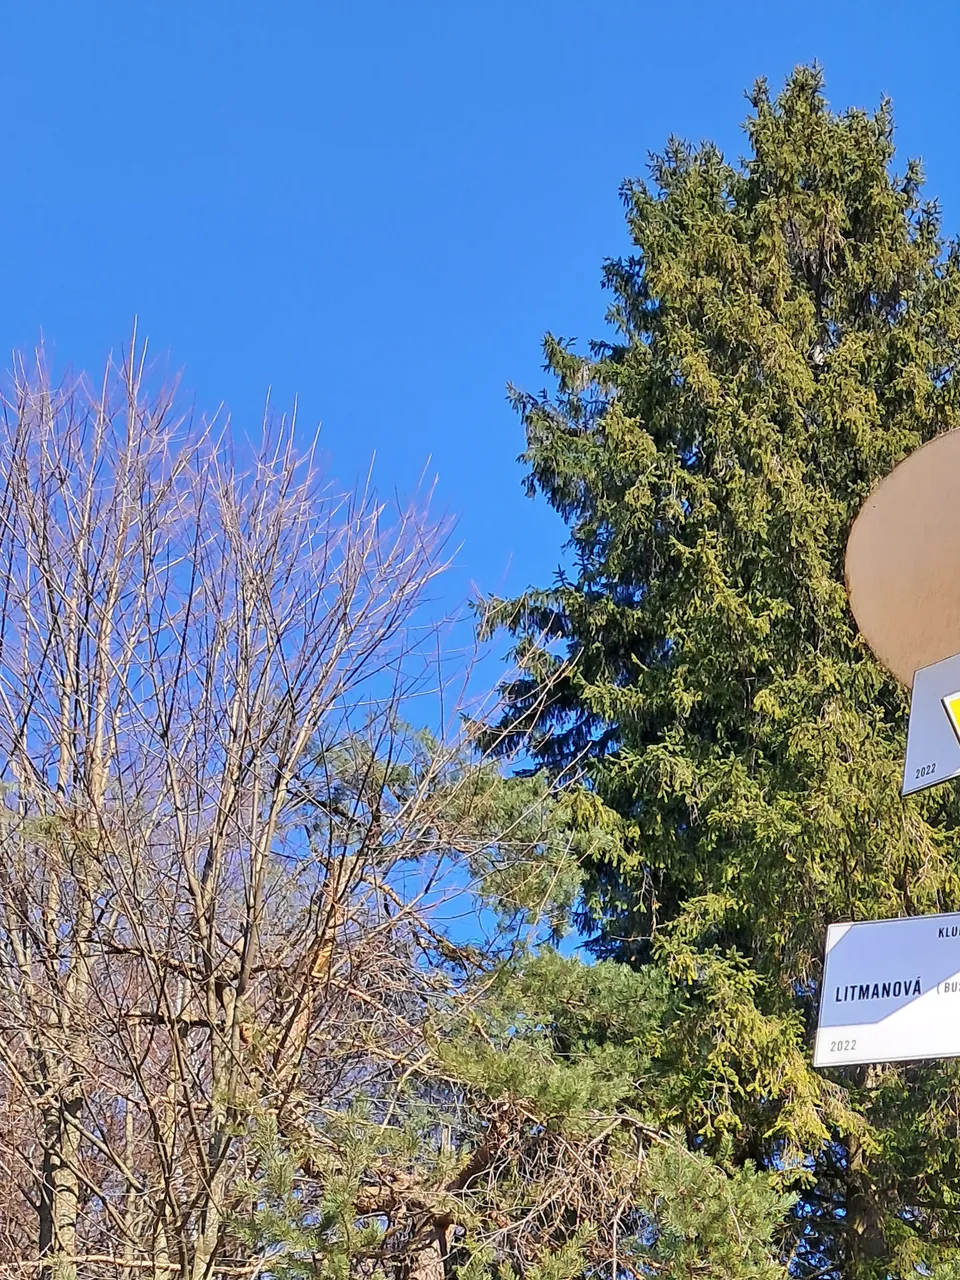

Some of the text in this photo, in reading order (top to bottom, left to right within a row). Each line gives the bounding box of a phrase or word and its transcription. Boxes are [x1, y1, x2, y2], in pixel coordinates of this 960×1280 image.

[914, 762, 938, 780] 2022
[834, 976, 923, 1003] LITMANOVÁ
[830, 1039, 858, 1053] 2022
